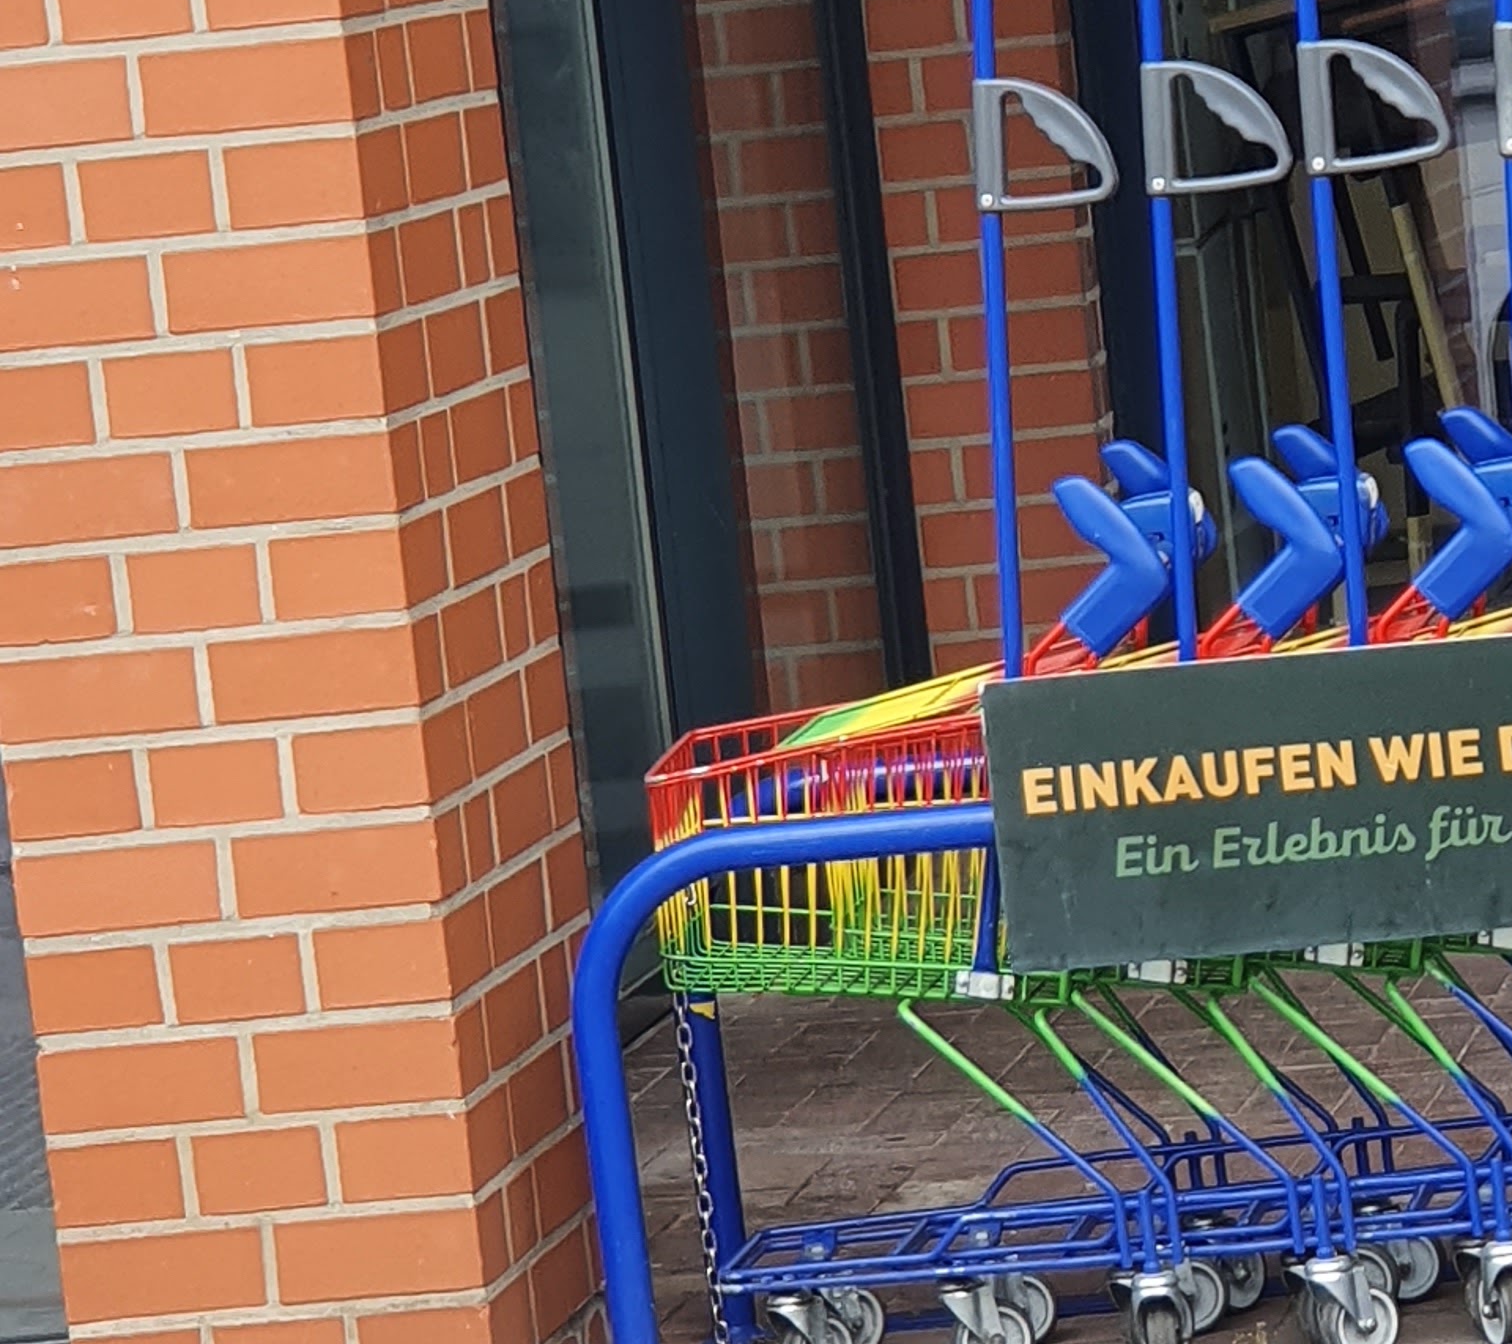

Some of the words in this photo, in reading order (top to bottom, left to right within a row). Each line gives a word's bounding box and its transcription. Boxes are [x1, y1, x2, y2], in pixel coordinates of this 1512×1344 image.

[1021, 741, 1357, 816] EINKAUFEN
[1368, 729, 1483, 783] WIE
[1115, 834, 1199, 878] Ein
[1212, 813, 1417, 869] Erlebnis
[1425, 804, 1512, 861] für
